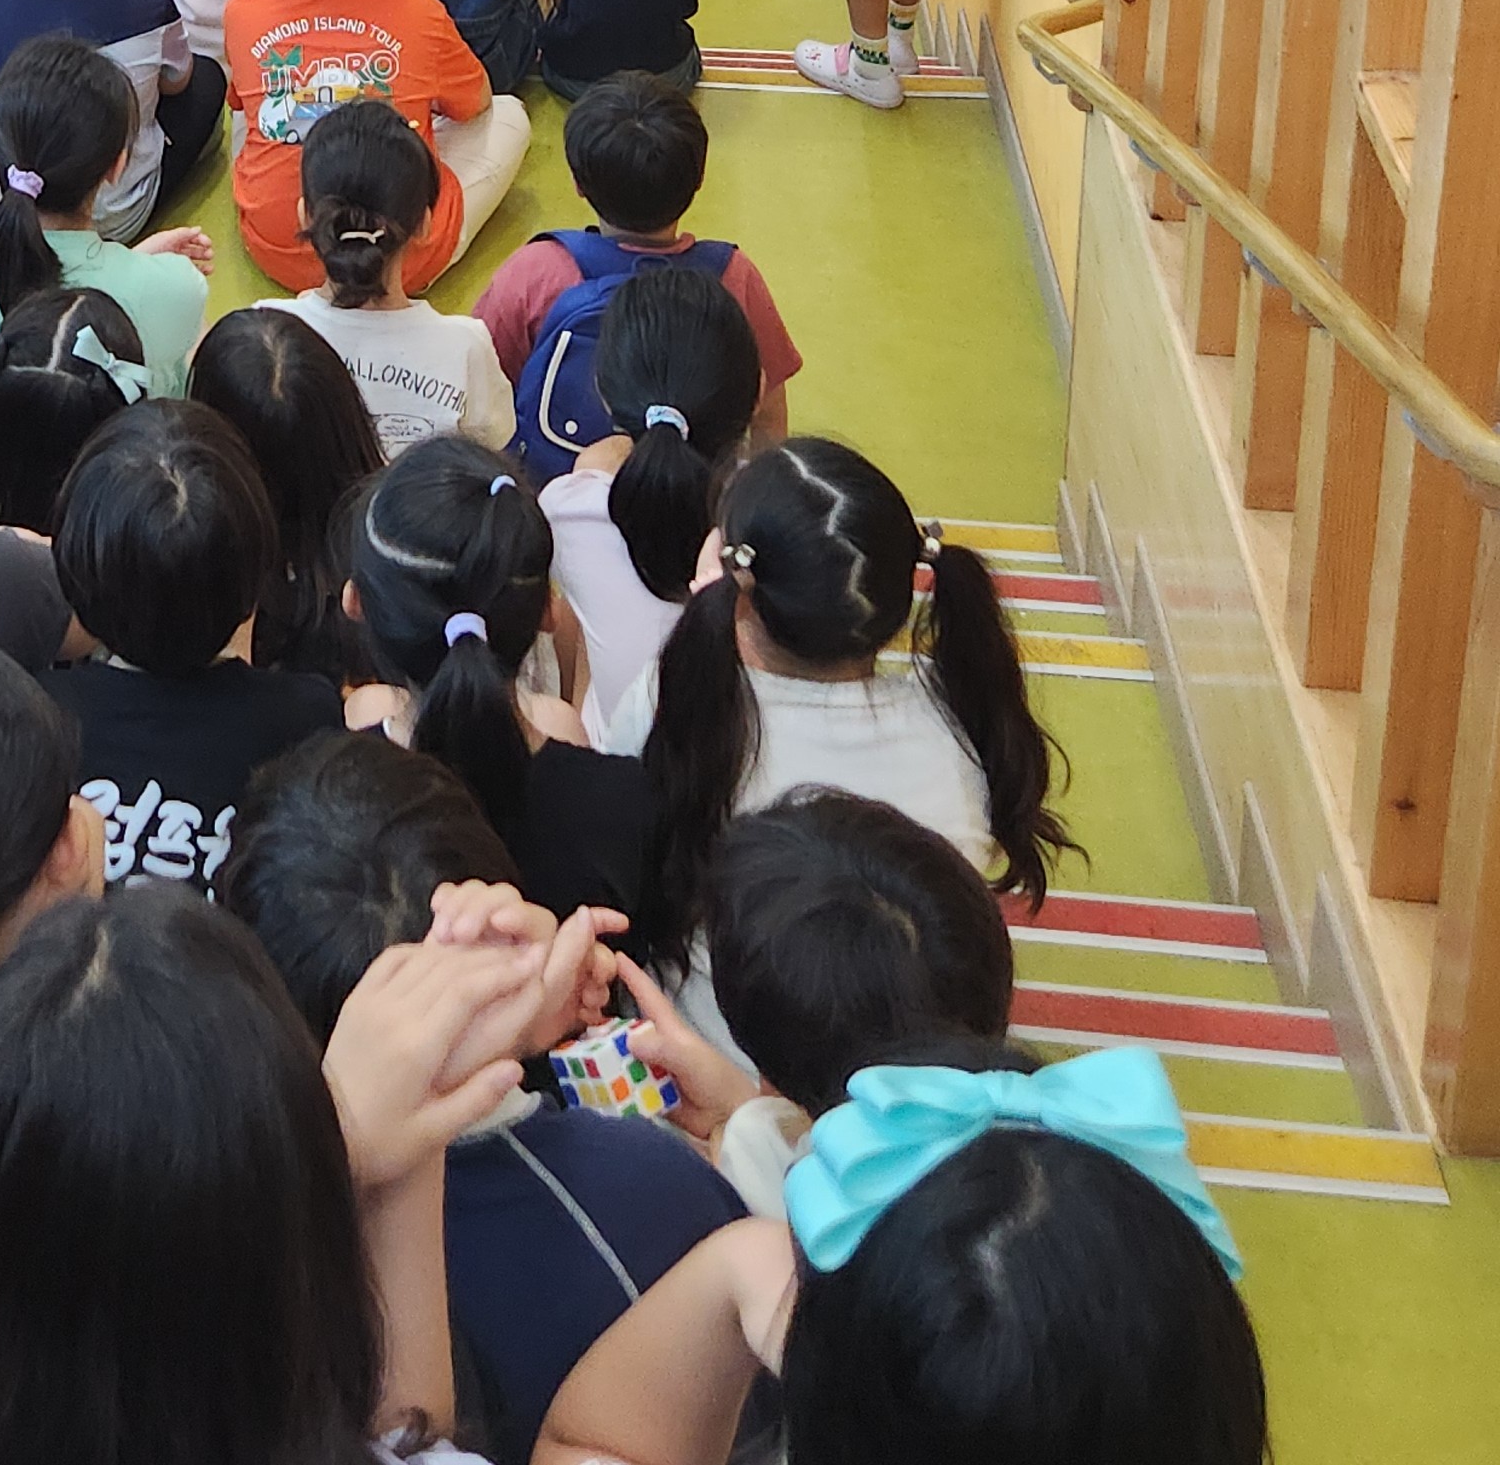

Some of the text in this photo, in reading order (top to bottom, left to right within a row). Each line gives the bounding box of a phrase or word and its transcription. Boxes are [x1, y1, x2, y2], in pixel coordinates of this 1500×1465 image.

[251, 16, 403, 59] DIAMOND ISLAND TOUR
